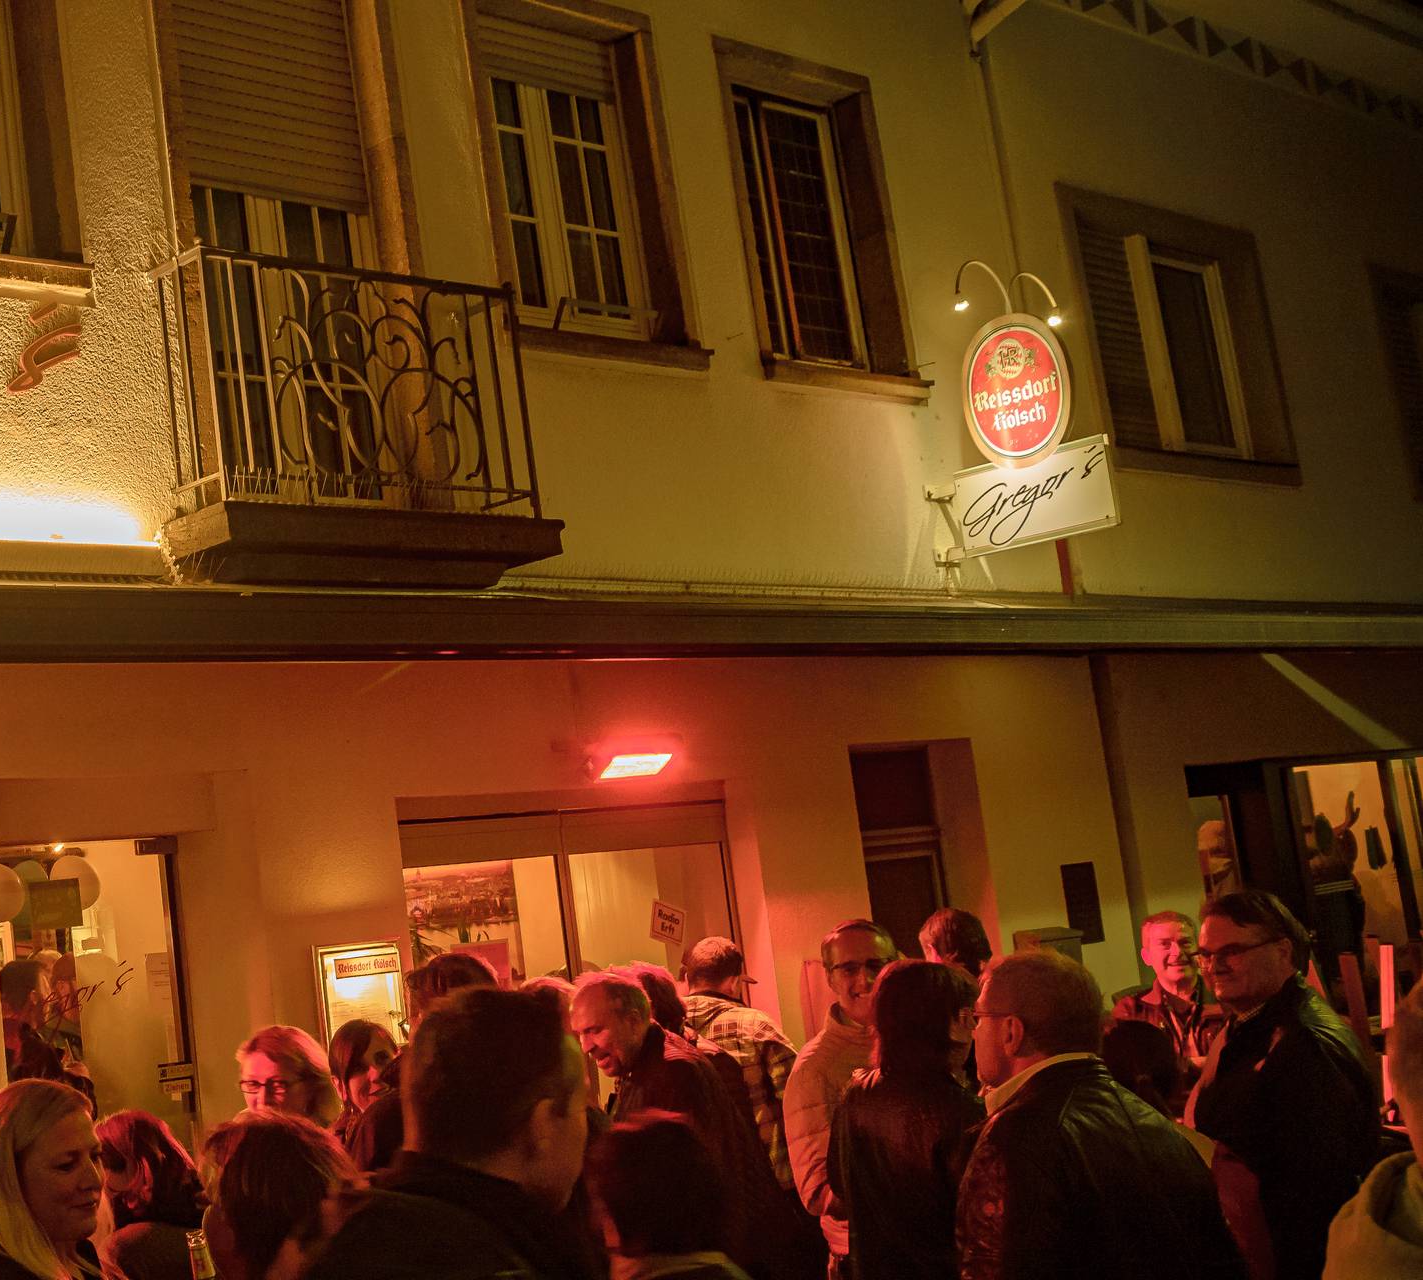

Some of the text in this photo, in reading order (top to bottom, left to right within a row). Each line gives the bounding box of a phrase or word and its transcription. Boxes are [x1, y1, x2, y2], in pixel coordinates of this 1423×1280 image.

[974, 371, 1057, 412] Reissdorf
[992, 401, 1047, 432] Kölsch
[658, 909, 680, 925] Radio
[337, 957, 397, 974] Reissdorf Kölsch
